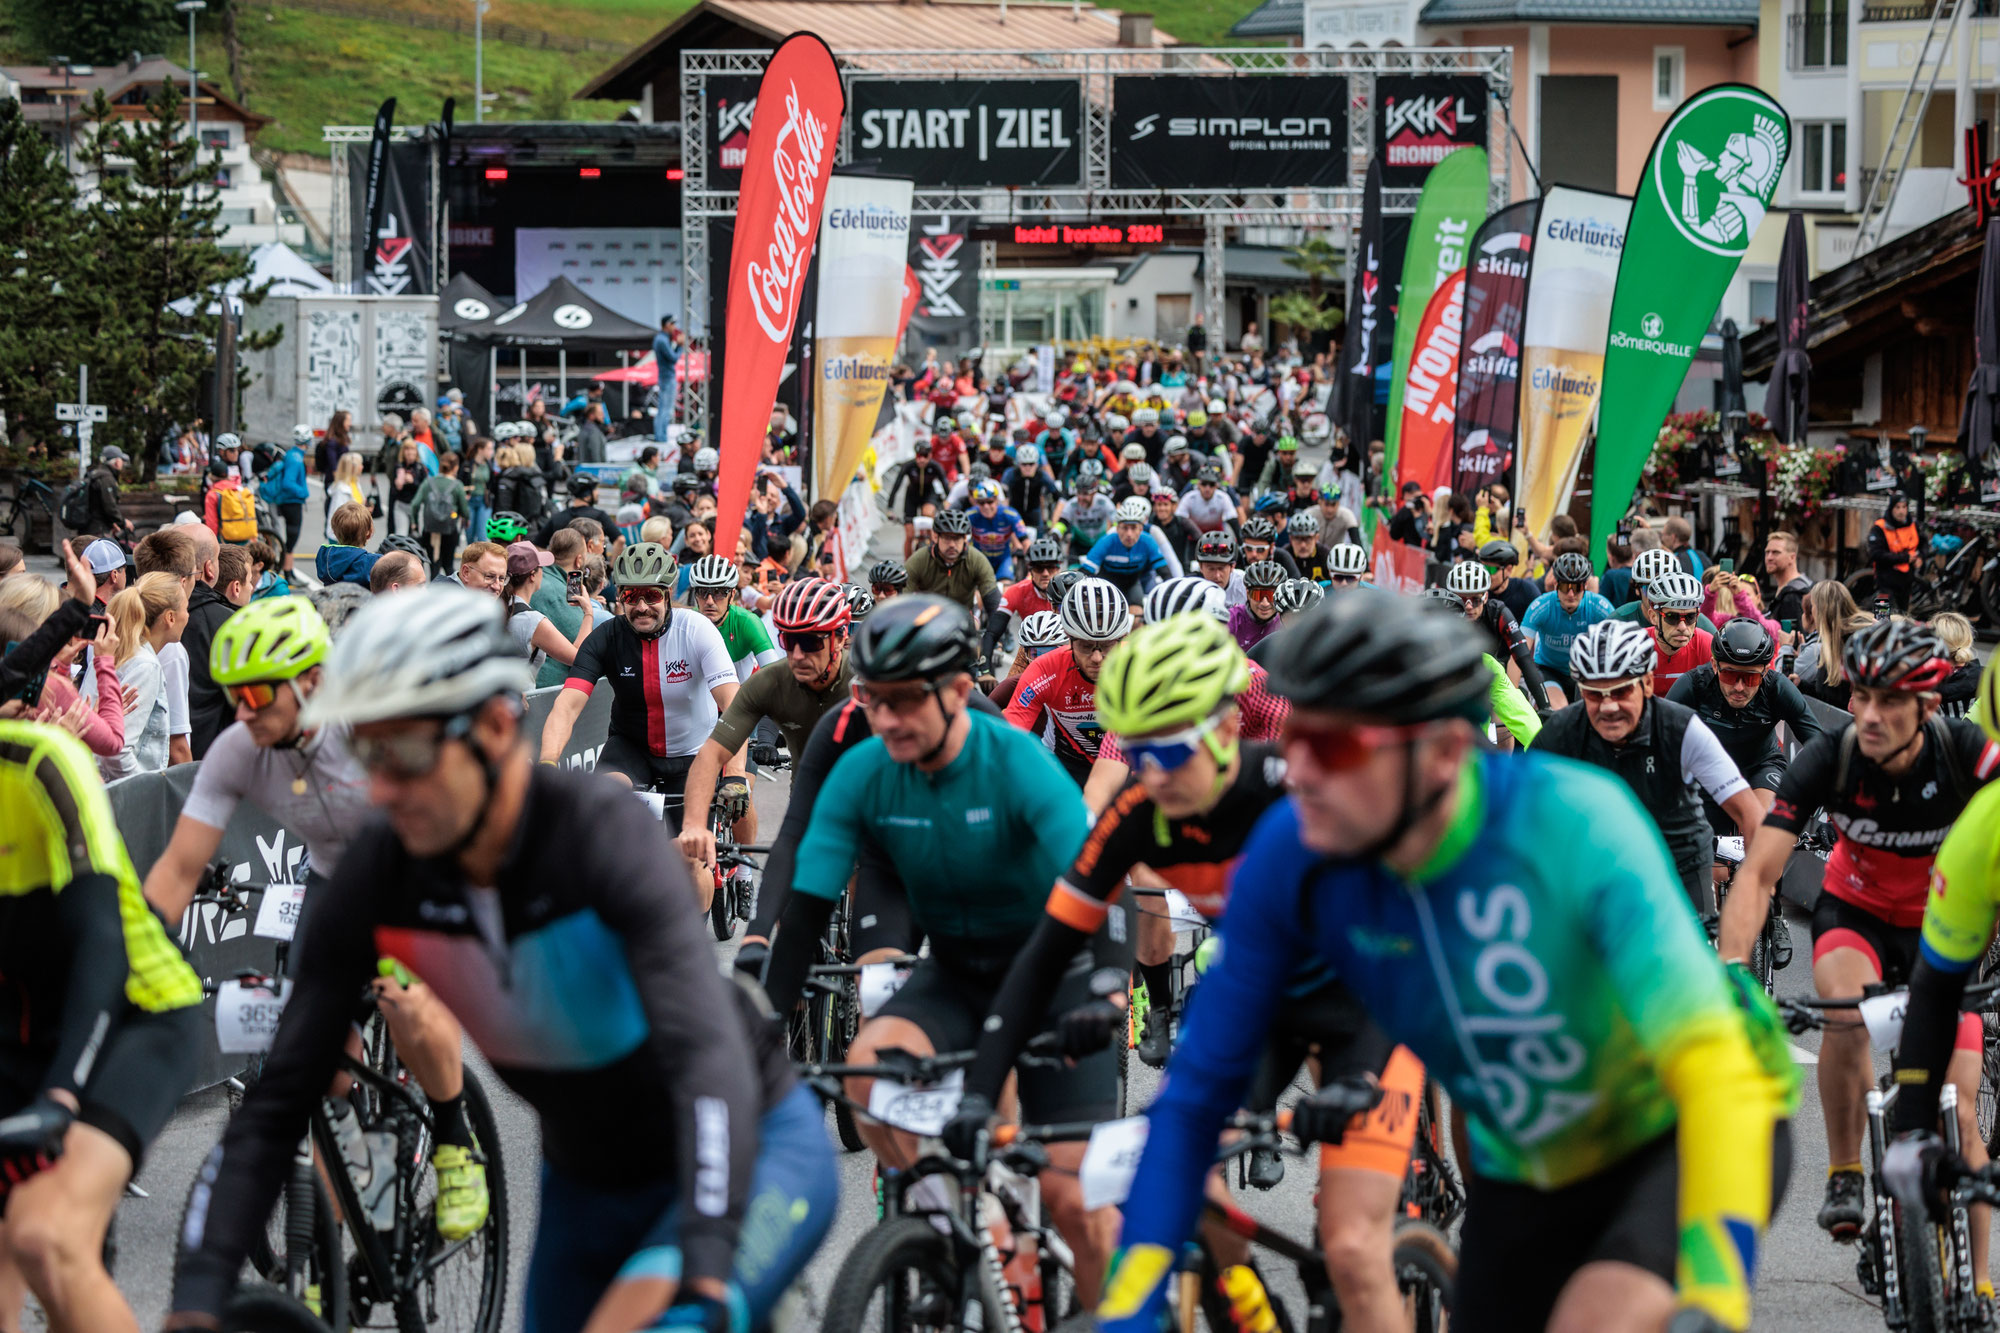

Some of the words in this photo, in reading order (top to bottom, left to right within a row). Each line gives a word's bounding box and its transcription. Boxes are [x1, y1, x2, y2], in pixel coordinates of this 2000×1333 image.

[861, 108, 970, 149] START
[996, 108, 1071, 148] ZIEL
[1168, 118, 1331, 136] SIMPLON
[1229, 140, 1267, 150] OFFICIAL
[748, 78, 824, 343] Coca-Cola
[829, 208, 907, 230] Edelweiss
[1127, 225, 1163, 243] 2024
[1548, 219, 1624, 250] Edelweis
[824, 359, 890, 381] Edelweis
[1532, 368, 1597, 397] Edelweis
[73, 405, 91, 416] WC
